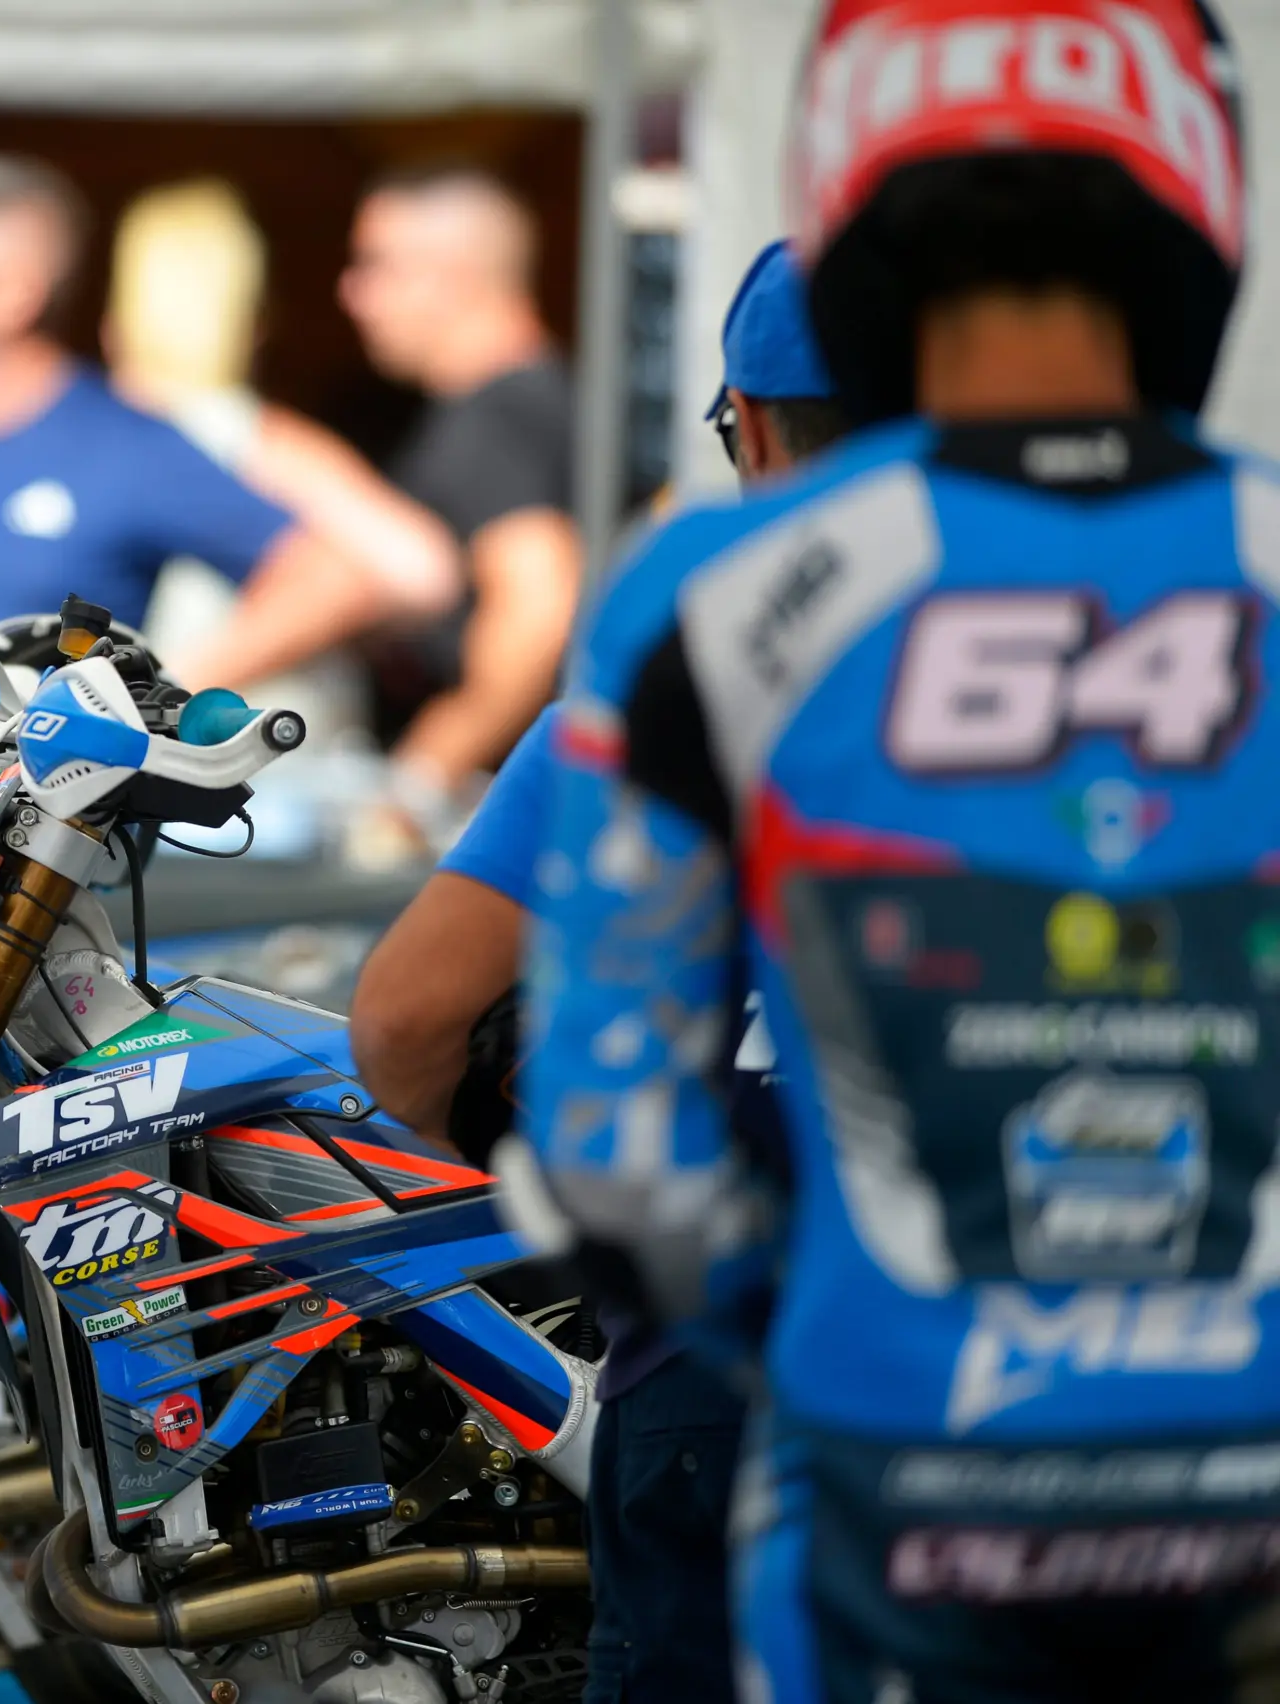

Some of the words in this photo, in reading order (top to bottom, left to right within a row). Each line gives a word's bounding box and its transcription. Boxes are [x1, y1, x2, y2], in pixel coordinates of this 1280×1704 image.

[888, 590, 1250, 772] 64
[65, 975, 94, 997] 64
[119, 1028, 192, 1053] MOTOREX
[94, 1064, 144, 1083] RACING
[3, 1052, 189, 1154] TSV
[32, 1126, 139, 1172] FACTORY
[150, 1112, 205, 1134] TEAM
[19, 1182, 176, 1272] tm
[53, 1239, 159, 1285] CORSE
[86, 1313, 125, 1333] Green
[143, 1291, 181, 1314] Power
[315, 1503, 350, 1514] WORLD
